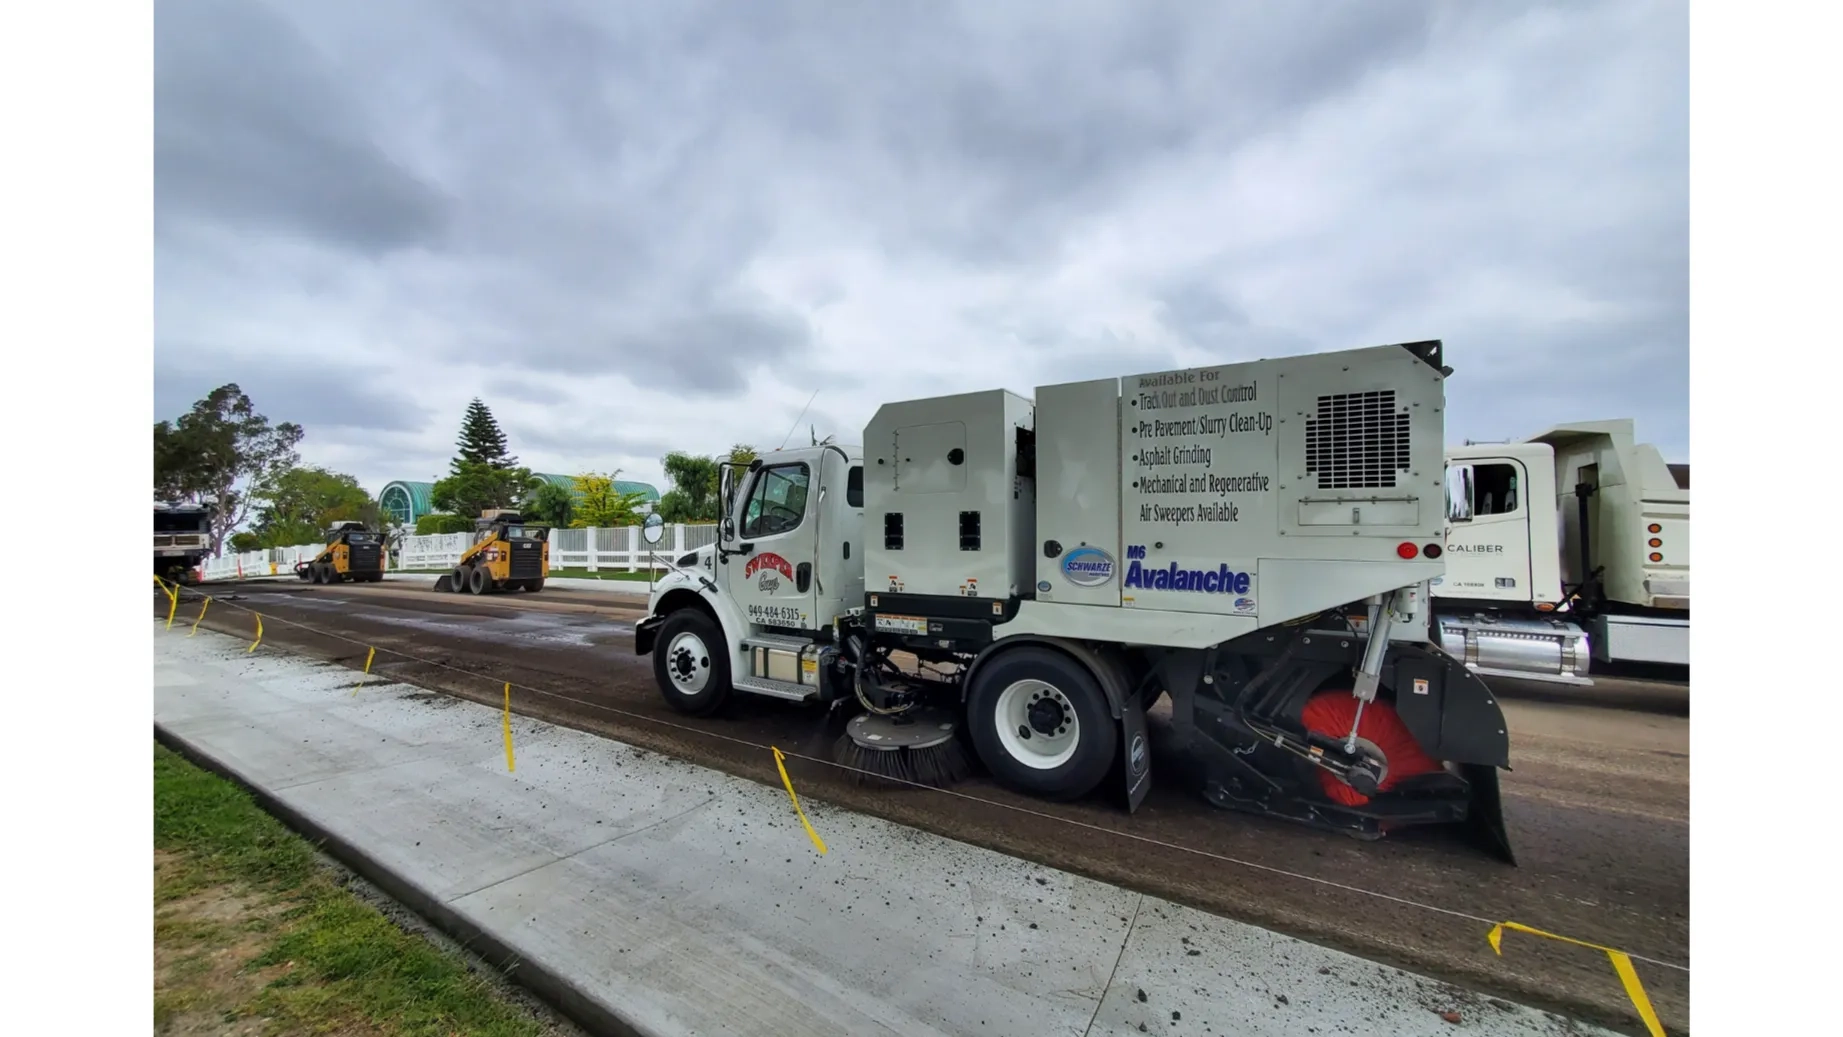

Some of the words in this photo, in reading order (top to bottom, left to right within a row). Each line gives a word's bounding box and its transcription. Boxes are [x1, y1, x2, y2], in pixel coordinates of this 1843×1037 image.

[1139, 372, 1195, 388] Available
[1200, 370, 1220, 382] For
[1139, 391, 1161, 411] Track
[1161, 390, 1177, 409] Out
[1179, 387, 1196, 407] and
[1199, 386, 1219, 406] Dust
[1221, 380, 1257, 404] Control
[1139, 421, 1152, 438] Pre
[1229, 412, 1272, 436] Clean-Up
[1139, 445, 1171, 470] Asphalt
[1173, 444, 1211, 468] Grinding
[1139, 473, 1187, 494] Mechanical
[1189, 473, 1206, 493] and
[1209, 471, 1269, 497] Regenerative
[1140, 503, 1151, 522] Air
[1154, 503, 1195, 526] Sweepers
[1197, 502, 1238, 522] Available
[1127, 545, 1146, 560] M6
[1447, 544, 1503, 553] CALIBER
[704, 556, 712, 570] 4
[1067, 561, 1111, 571] SCHWARZE
[1124, 560, 1250, 595] Avalanche
[748, 604, 800, 621] 949-484-6315
